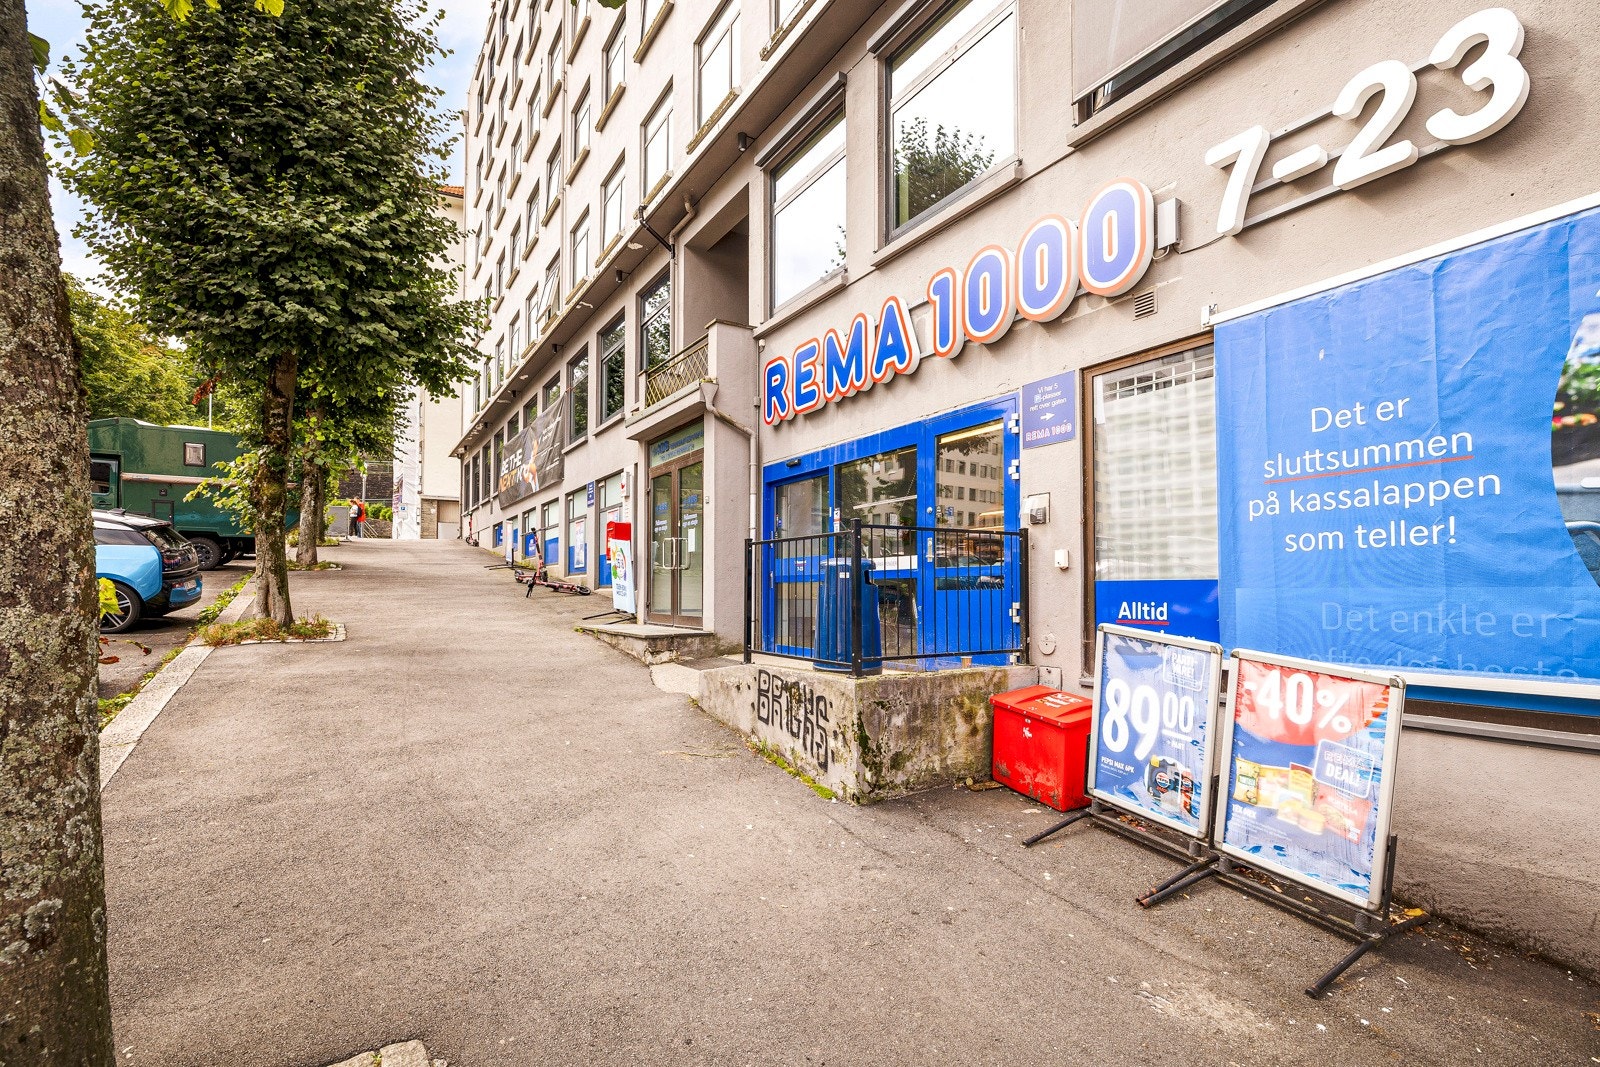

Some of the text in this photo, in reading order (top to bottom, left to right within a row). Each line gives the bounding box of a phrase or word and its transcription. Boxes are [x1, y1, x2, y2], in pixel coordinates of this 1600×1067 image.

[1205, 7, 1530, 236] 7-23
[764, 177, 1152, 426] REMA 1000
[1310, 396, 1411, 433] Det er
[1263, 430, 1473, 480] sluttsummen
[1249, 473, 1501, 522] på kassalappen
[1285, 515, 1457, 552] som teller!
[1118, 601, 1168, 621] Alltid
[1321, 601, 1562, 638] Det enkle er
[1103, 679, 1159, 761] 89
[1244, 670, 1352, 733] -40%
[1101, 756, 1114, 767] PEPSI
